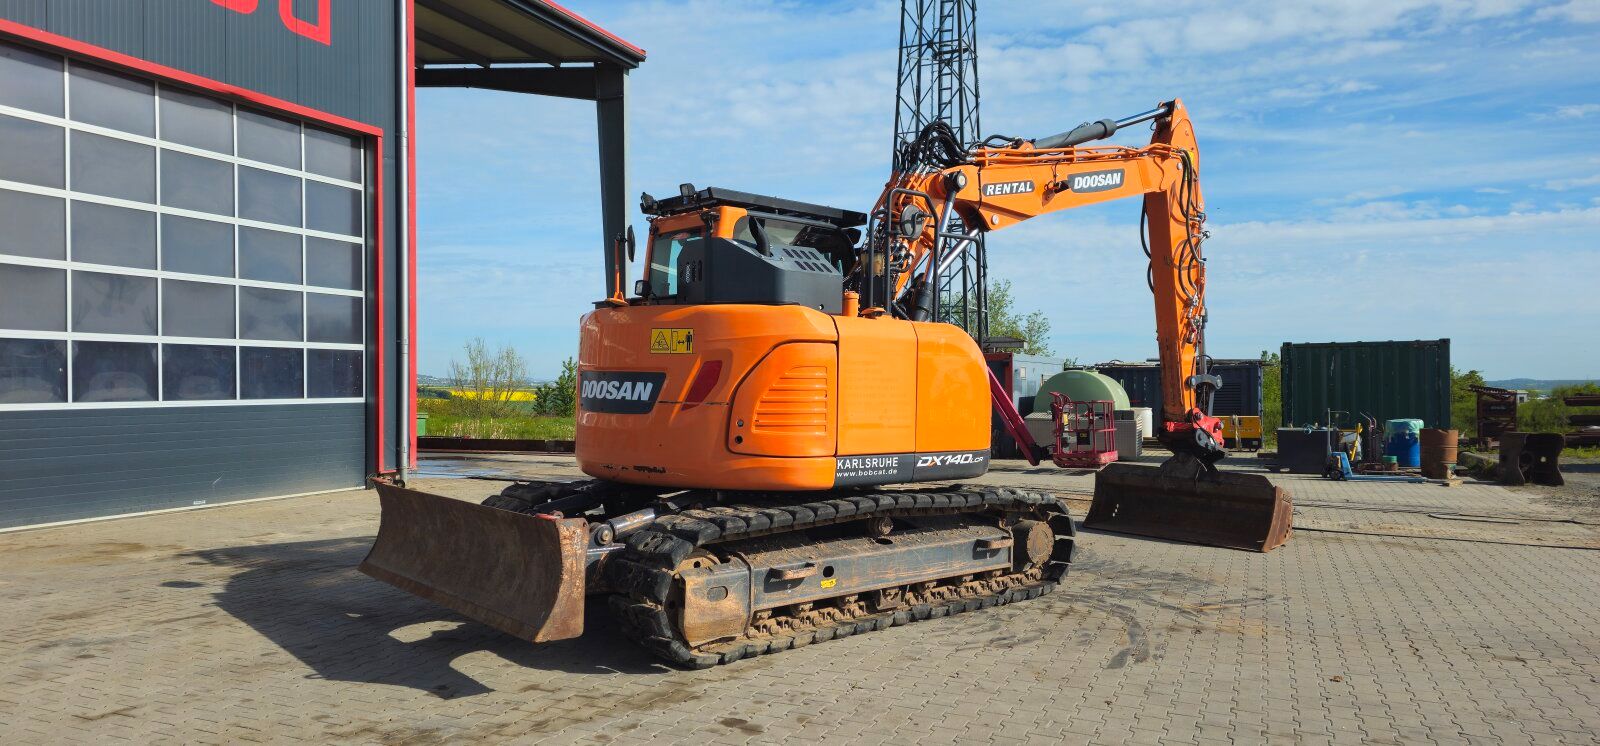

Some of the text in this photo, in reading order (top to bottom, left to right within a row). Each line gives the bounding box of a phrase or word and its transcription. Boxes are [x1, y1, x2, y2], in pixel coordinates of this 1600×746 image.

[1073, 172, 1122, 190] DOOSAN
[986, 182, 1033, 196] RENTAL
[581, 380, 654, 401] DOOSAN
[837, 457, 899, 470] KARLSRUHE
[836, 468, 898, 478] www.bobcat.de
